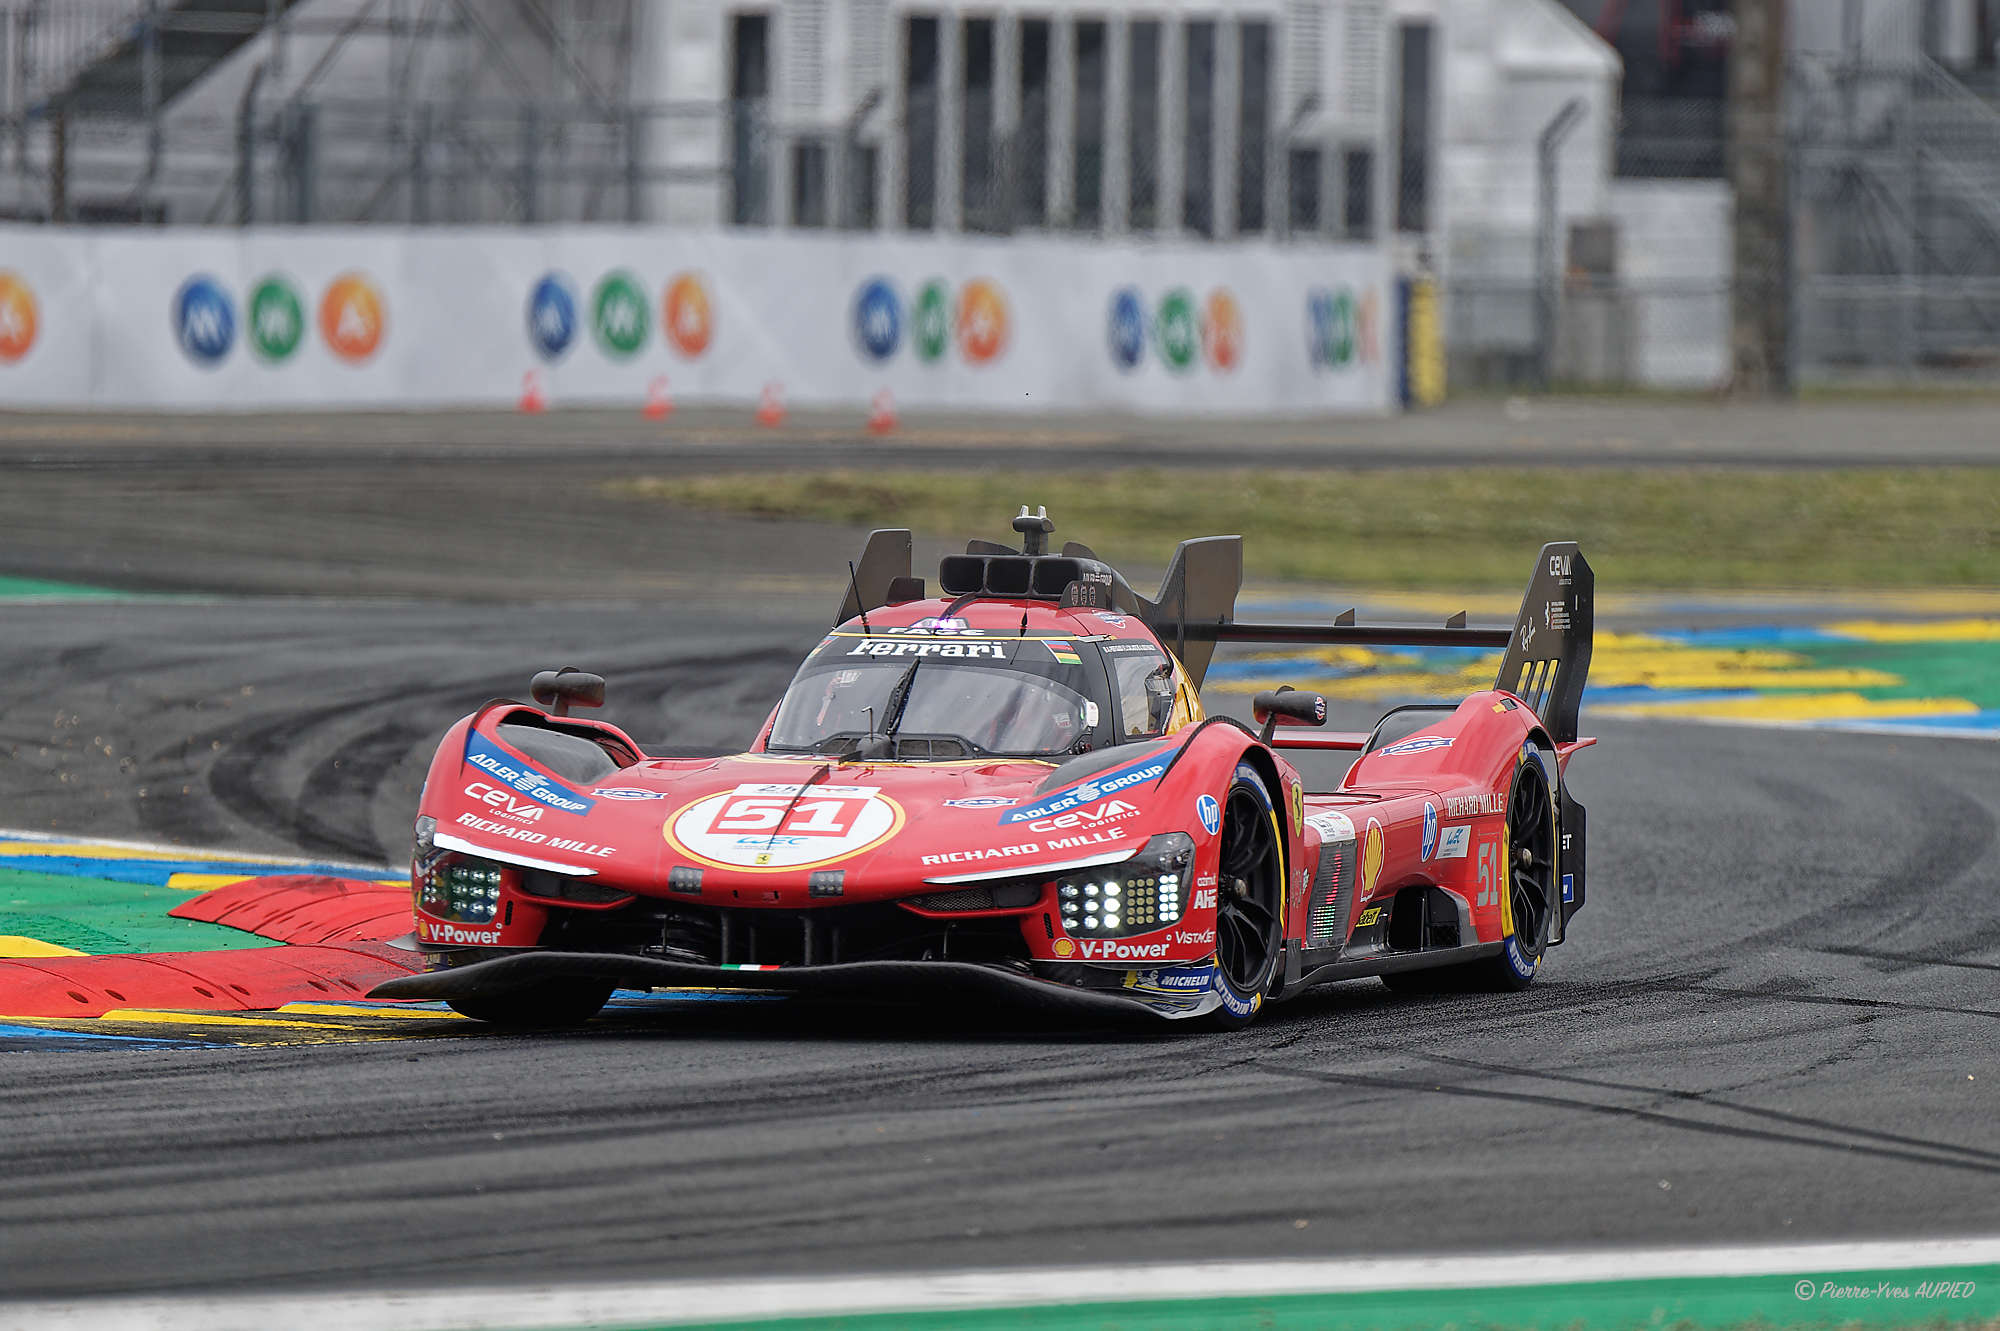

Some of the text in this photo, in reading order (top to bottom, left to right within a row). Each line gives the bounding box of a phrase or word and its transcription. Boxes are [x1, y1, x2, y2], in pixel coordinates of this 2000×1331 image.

[846, 638, 1007, 659] Ferrari
[468, 753, 587, 811] ADLER GROUP
[1011, 764, 1164, 822] ADLER GROUP
[464, 782, 544, 821] CEVA
[489, 808, 535, 825] LOGISTICS
[717, 799, 846, 833] 51
[1028, 799, 1137, 833] CEVA
[1199, 796, 1218, 834] hp
[1446, 792, 1503, 817] RICHARD MILLE
[456, 812, 617, 858] RICHARD MILLE
[1081, 810, 1141, 830] LOGISTICS
[1424, 804, 1437, 859] hp
[922, 826, 1127, 865] RICHARD MILLE
[1477, 842, 1498, 907] 51
[429, 923, 501, 944] V-Power
[1080, 941, 1170, 959] V-Power
[1161, 975, 1210, 987] MICHELIN
